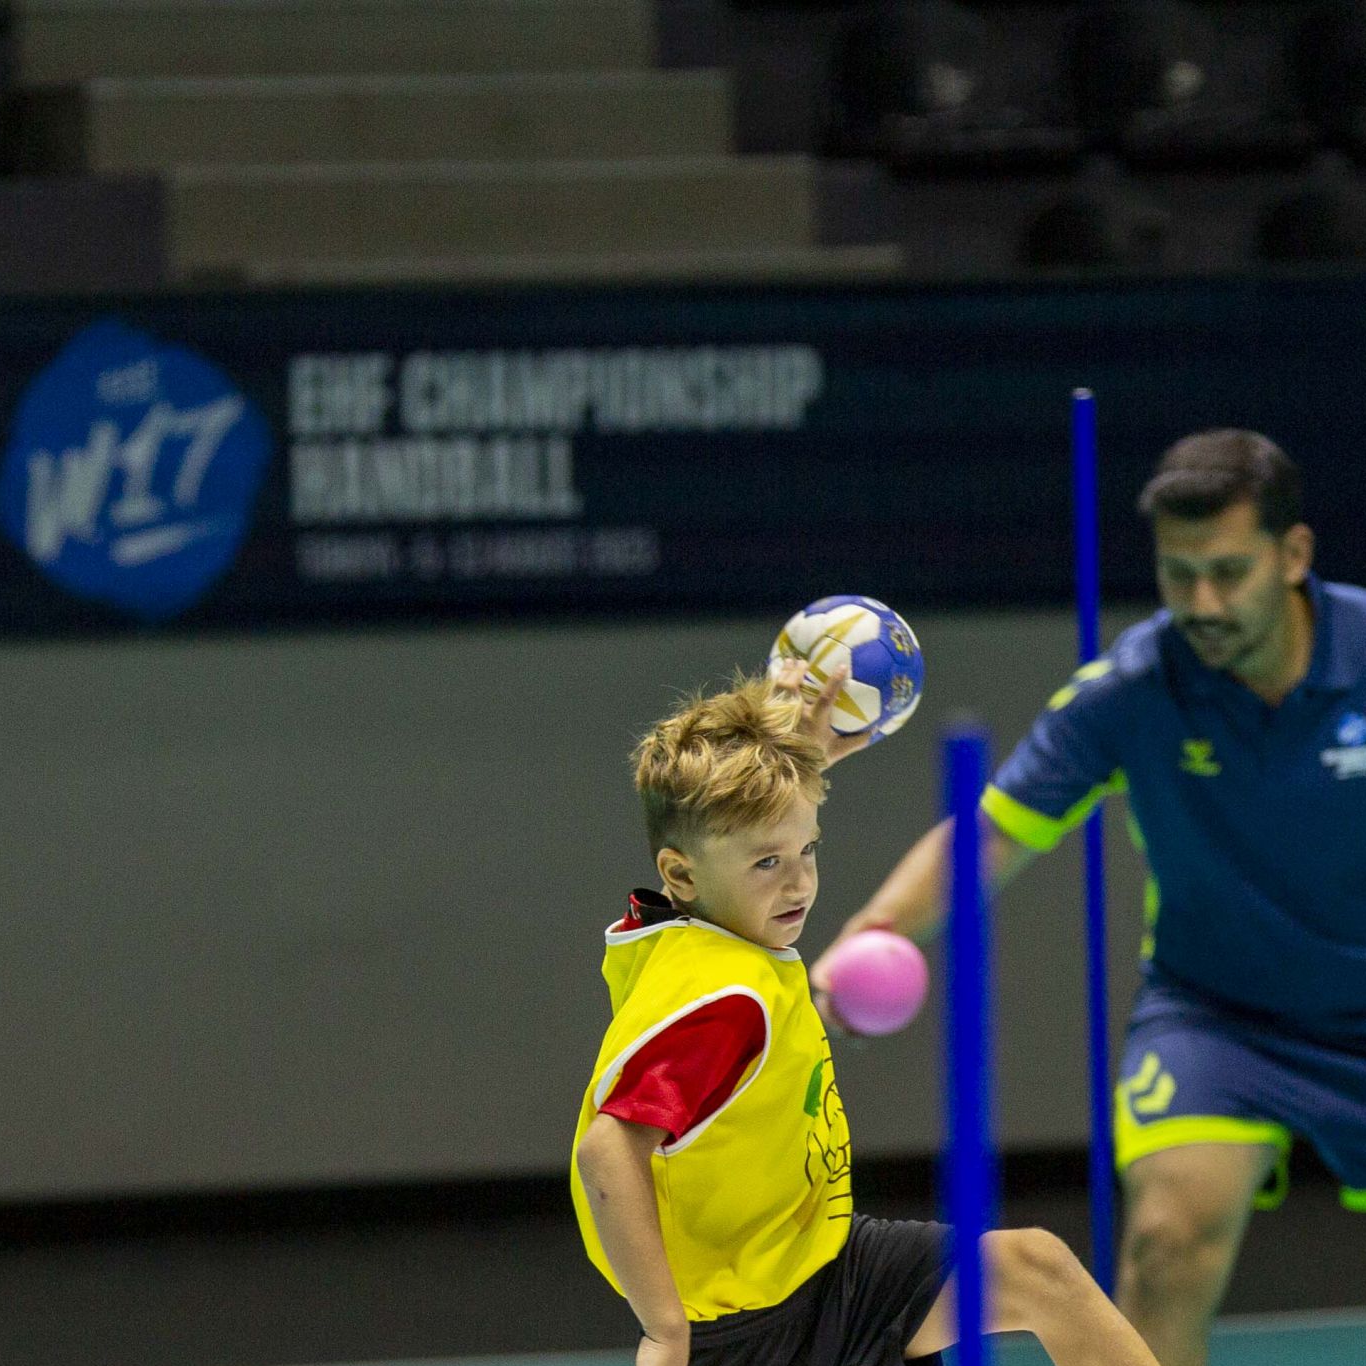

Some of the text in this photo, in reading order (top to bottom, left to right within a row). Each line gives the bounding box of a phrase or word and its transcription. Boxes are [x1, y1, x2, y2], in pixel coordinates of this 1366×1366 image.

[288, 344, 824, 434] EHF CHAMPIONSHIP
[24, 393, 246, 566] W17
[289, 437, 584, 522] HANDBALL
